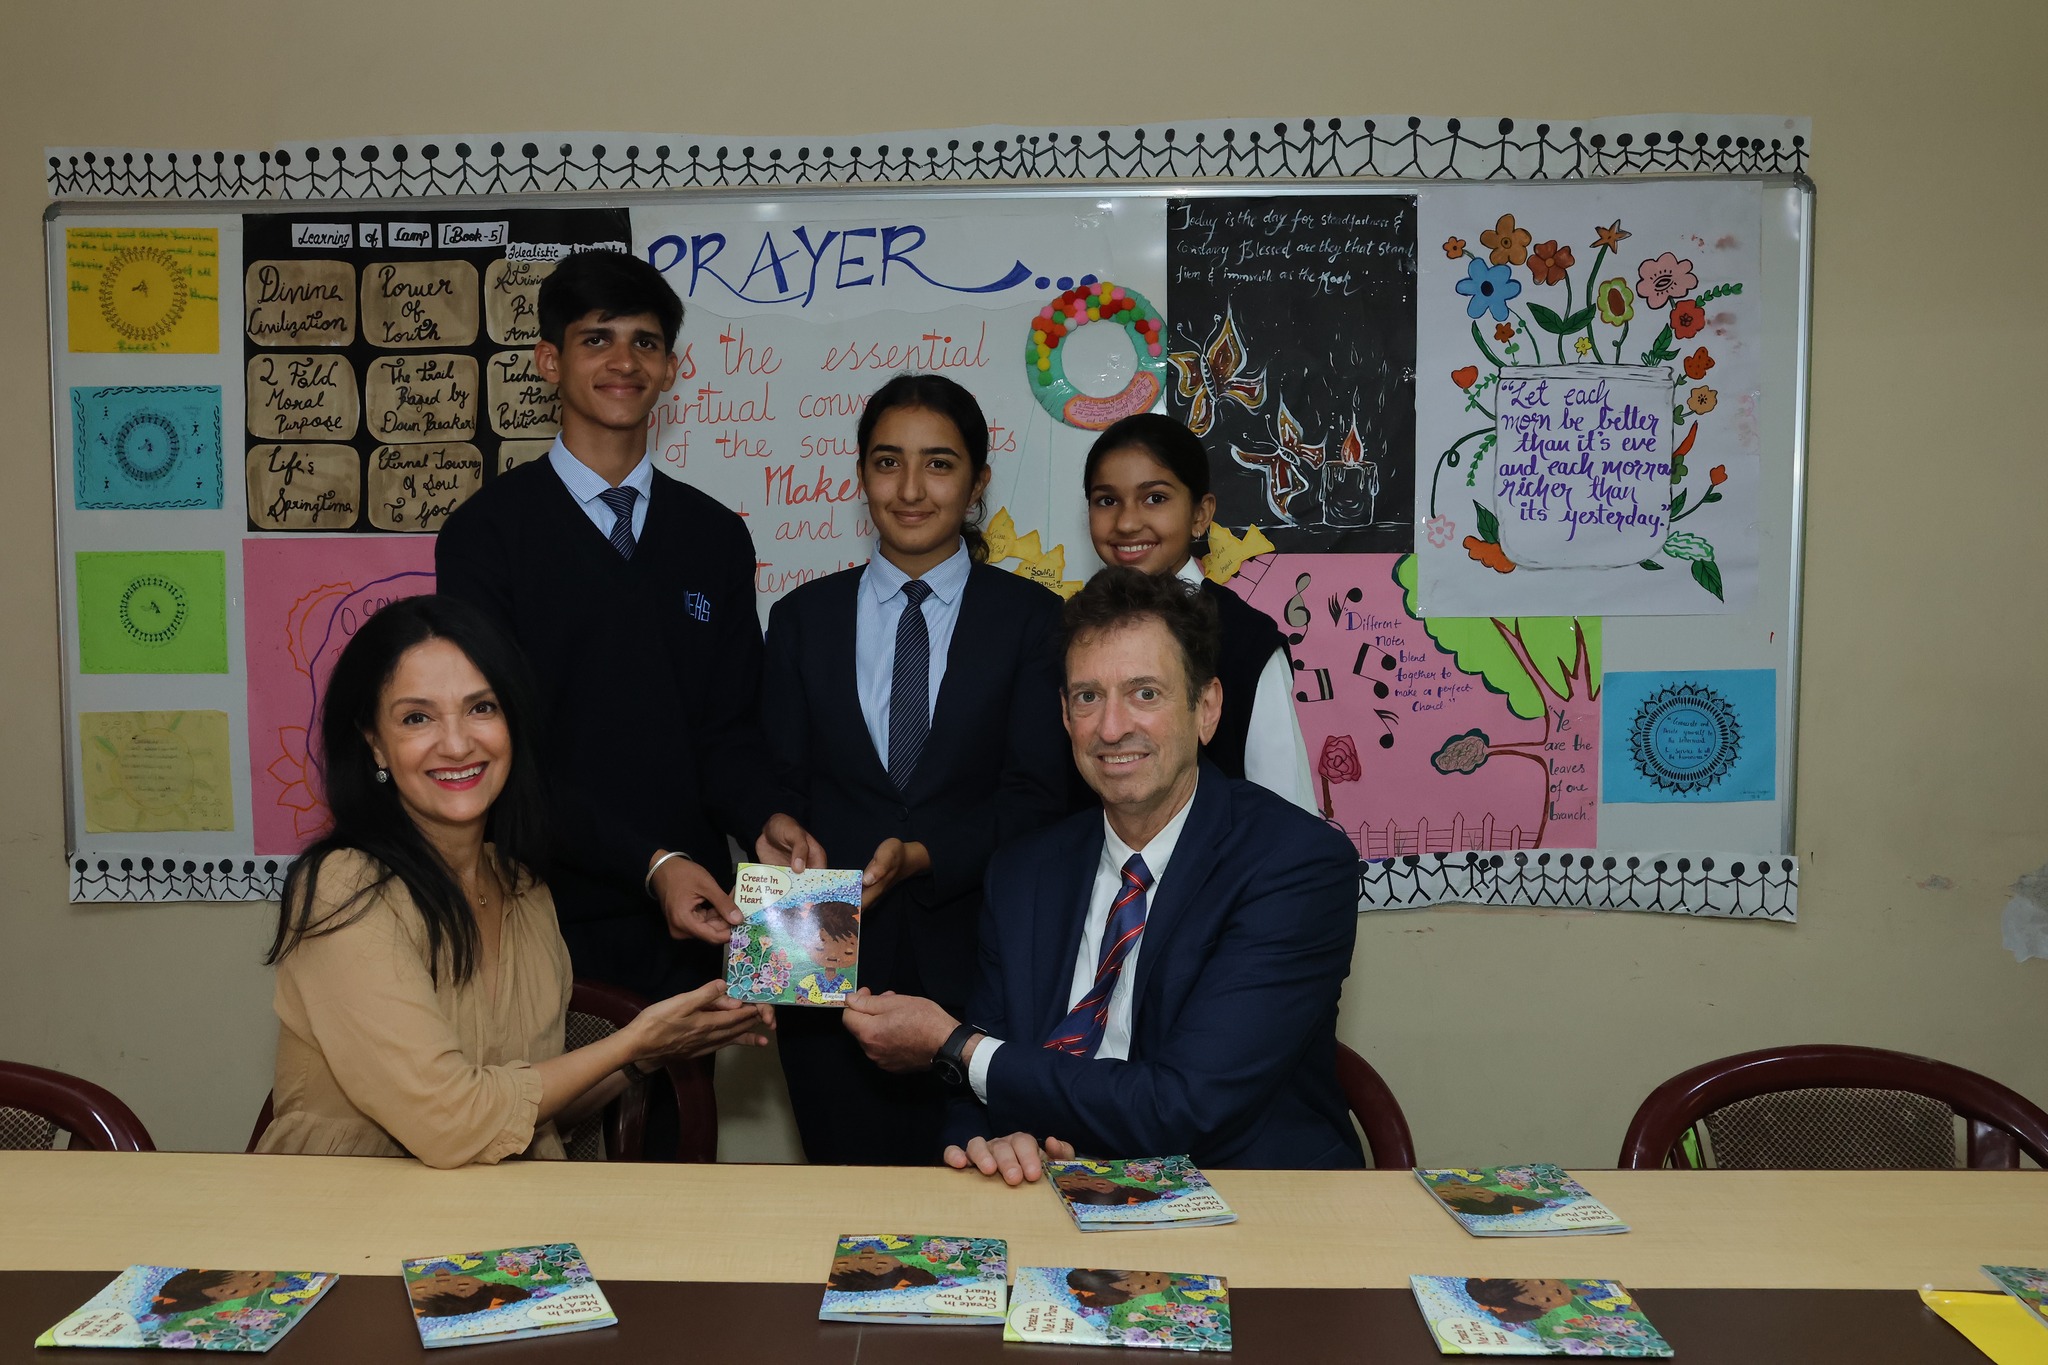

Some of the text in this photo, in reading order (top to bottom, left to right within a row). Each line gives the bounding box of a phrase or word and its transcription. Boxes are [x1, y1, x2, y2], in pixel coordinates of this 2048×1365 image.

[1225, 211, 1235, 227] is
[1238, 209, 1254, 228] the
[1263, 208, 1288, 236] day
[1290, 209, 1314, 232] for
[298, 226, 350, 248] Learning
[365, 228, 378, 248] of
[508, 244, 559, 260] Idealistic
[1236, 240, 1293, 265] Blessed
[1296, 244, 1316, 254] are
[1318, 238, 1342, 263] they
[1344, 237, 1376, 256] that
[257, 266, 344, 304] Divine
[378, 265, 454, 298] Power
[1279, 270, 1295, 280] as
[1298, 267, 1316, 282] the
[246, 308, 348, 338] Civilization
[382, 318, 441, 344] Youth
[720, 323, 783, 376] the
[820, 320, 990, 372] essential
[260, 358, 338, 388] 2 Fold
[381, 358, 410, 385] The
[266, 388, 324, 410] Moral
[448, 382, 470, 409] by
[1564, 380, 1614, 412] each
[275, 414, 342, 434] Purpose
[380, 410, 420, 434] Dawn
[1501, 404, 1659, 436] morn be better
[666, 430, 692, 468] of
[715, 430, 772, 458] the
[800, 435, 861, 458] sou
[1513, 430, 1656, 460] than it's eve
[268, 446, 315, 486] Life's
[378, 447, 428, 470] Eternal
[432, 448, 482, 480] Journey
[1500, 454, 1539, 476] and
[1548, 452, 1594, 480] each
[422, 474, 460, 496] Soul
[1498, 475, 1638, 510] richer than
[267, 487, 354, 523] Springtime
[384, 497, 457, 528] To God
[1520, 500, 1548, 522] its
[775, 506, 842, 540] and
[1400, 650, 1426, 662] blend
[1394, 686, 1418, 697] make
[1438, 684, 1473, 698] perfect
[1396, 667, 1452, 688] together to
[1544, 734, 1593, 752] are the
[1550, 758, 1586, 776] leaves
[1550, 780, 1588, 802] of one
[740, 884, 784, 896] Me A Pure
[742, 873, 778, 884] Create In
[740, 895, 763, 904] Heart
